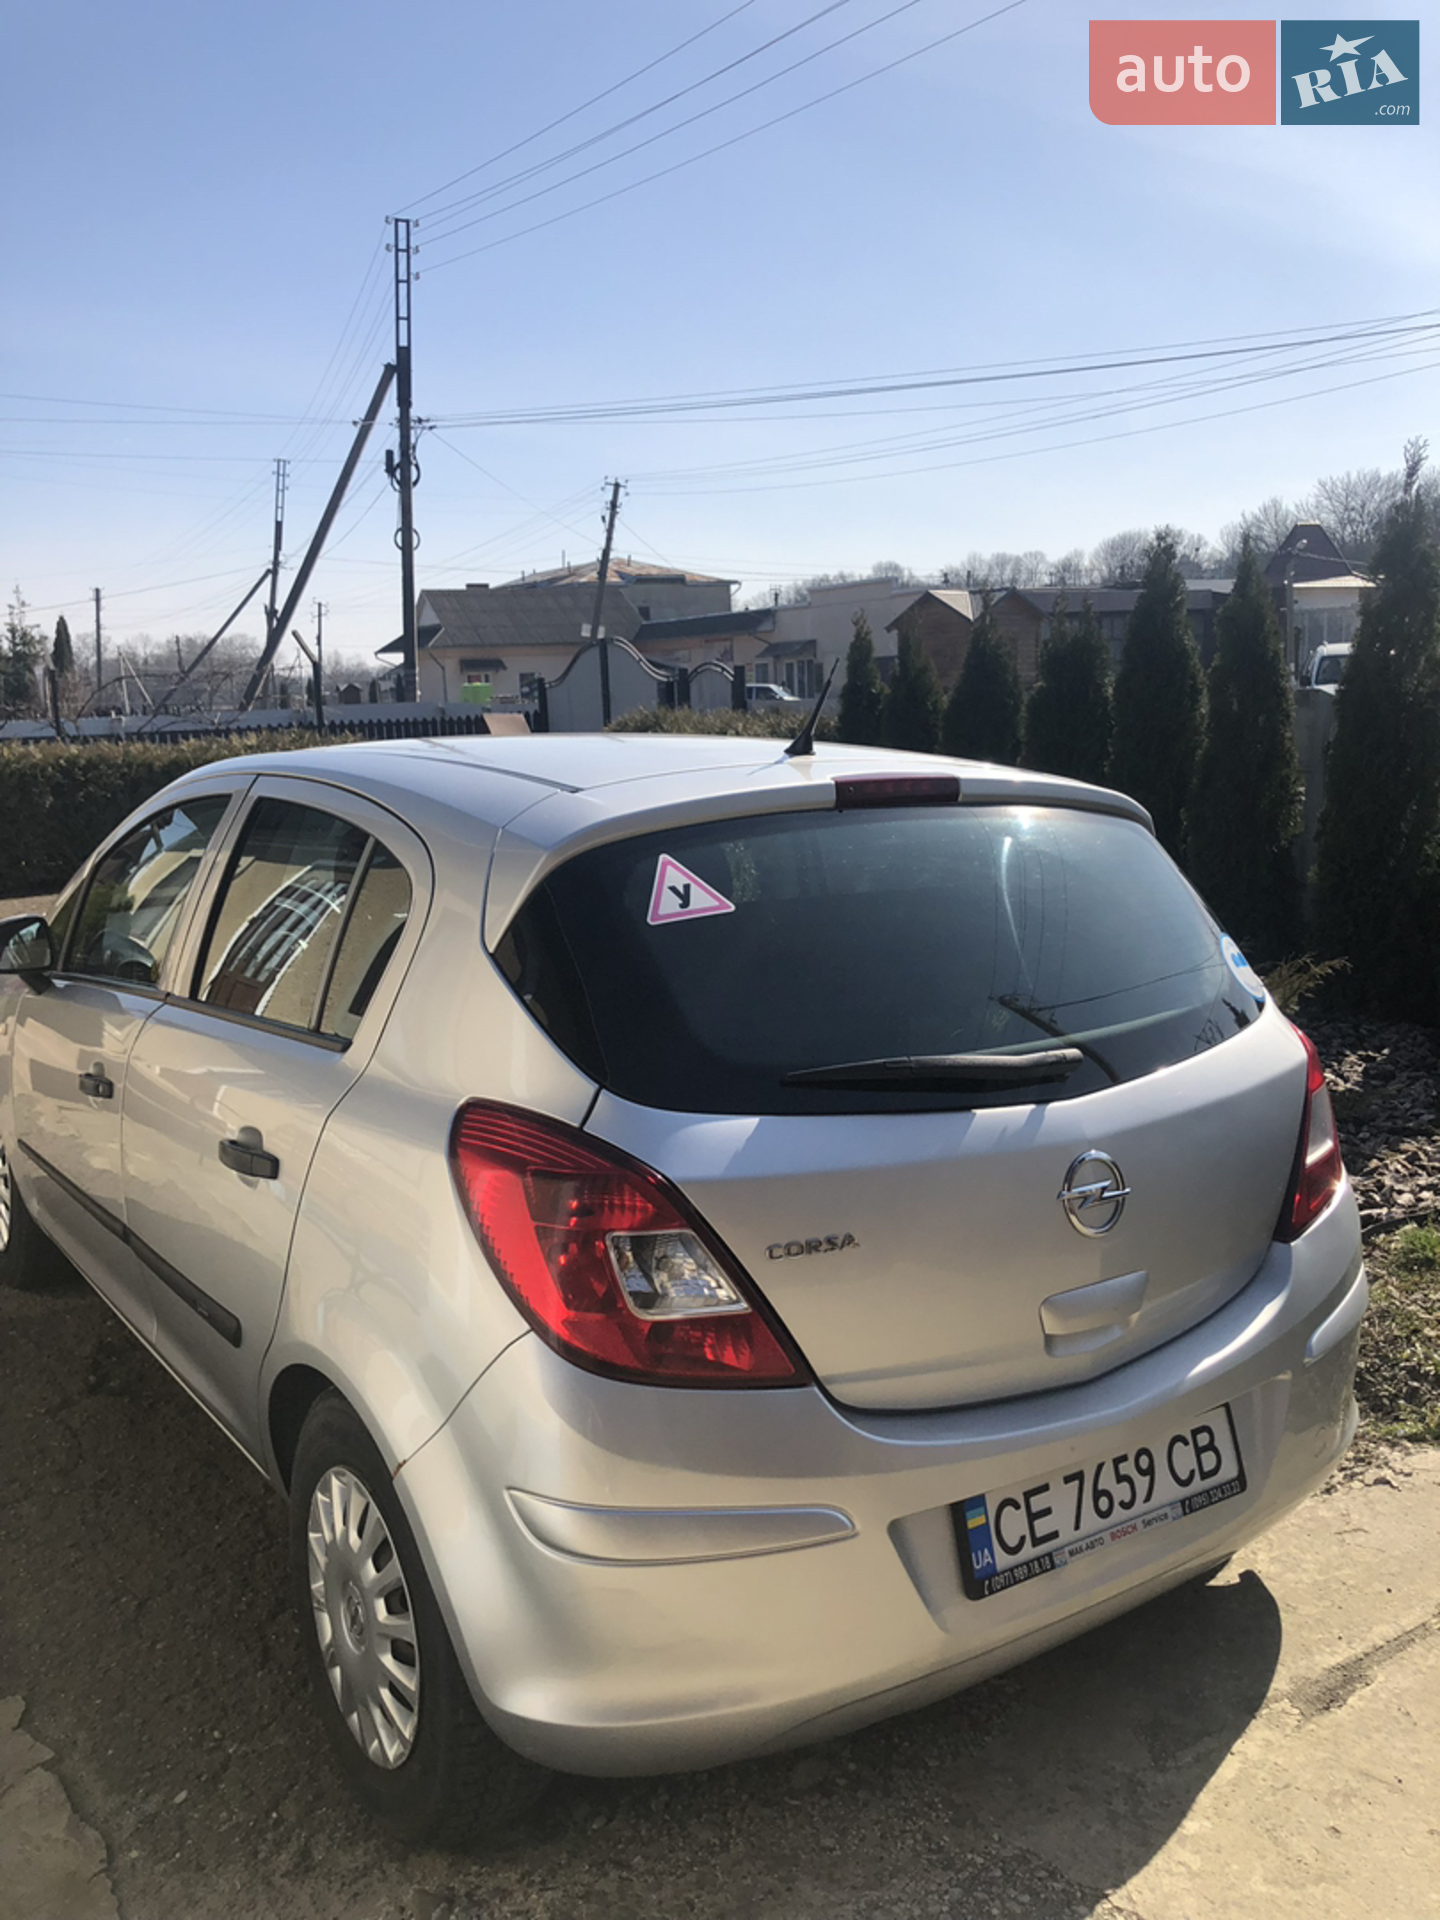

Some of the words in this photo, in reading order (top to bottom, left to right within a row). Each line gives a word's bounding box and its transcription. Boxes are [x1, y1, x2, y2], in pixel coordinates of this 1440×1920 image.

[764, 1231, 860, 1262] CORSA
[994, 1482, 1060, 1556] CE
[1063, 1446, 1155, 1532] 7659
[1167, 1424, 1222, 1488] CB
[1109, 1522, 1138, 1542] BOSCH
[1141, 1512, 1169, 1530] Service
[971, 1548, 993, 1569] UA
